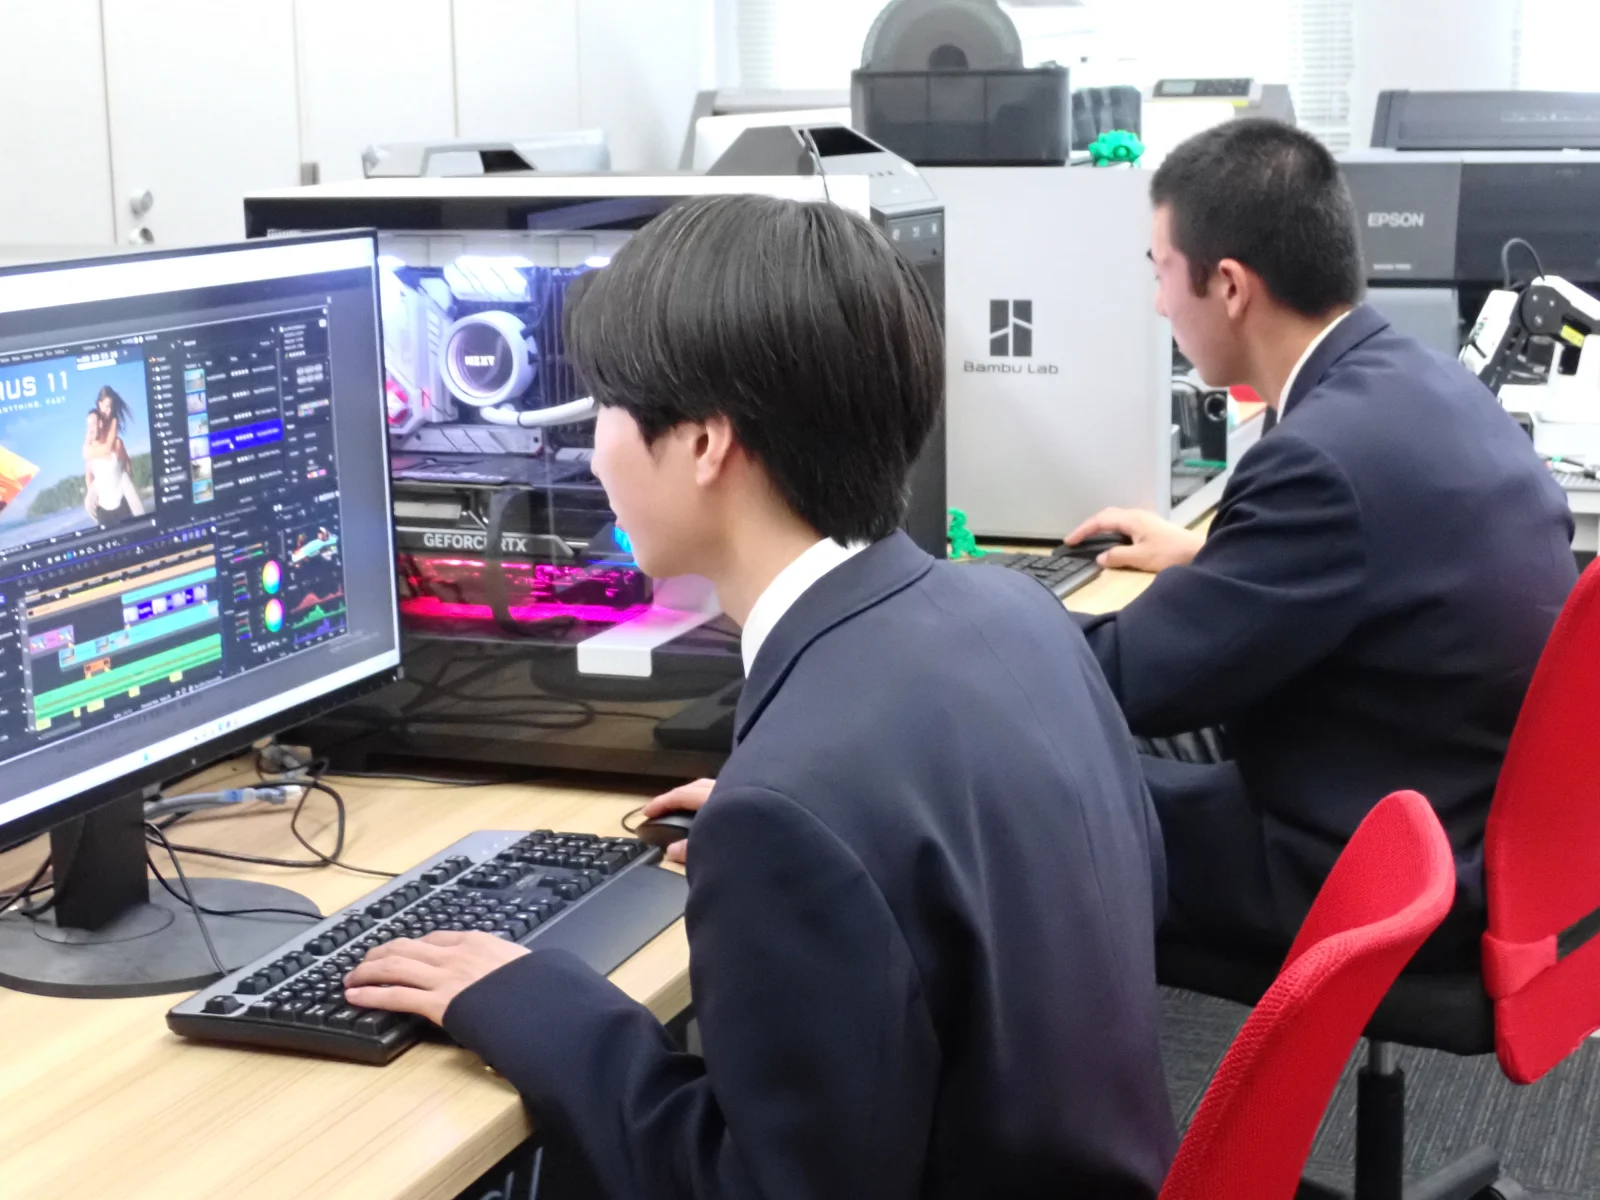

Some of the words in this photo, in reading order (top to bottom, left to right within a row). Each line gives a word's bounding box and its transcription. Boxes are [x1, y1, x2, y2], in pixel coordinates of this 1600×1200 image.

[1367, 212, 1424, 228] EPSON
[963, 360, 1023, 374] Bambu
[1027, 363, 1059, 375] Lab
[47, 371, 68, 393] 11
